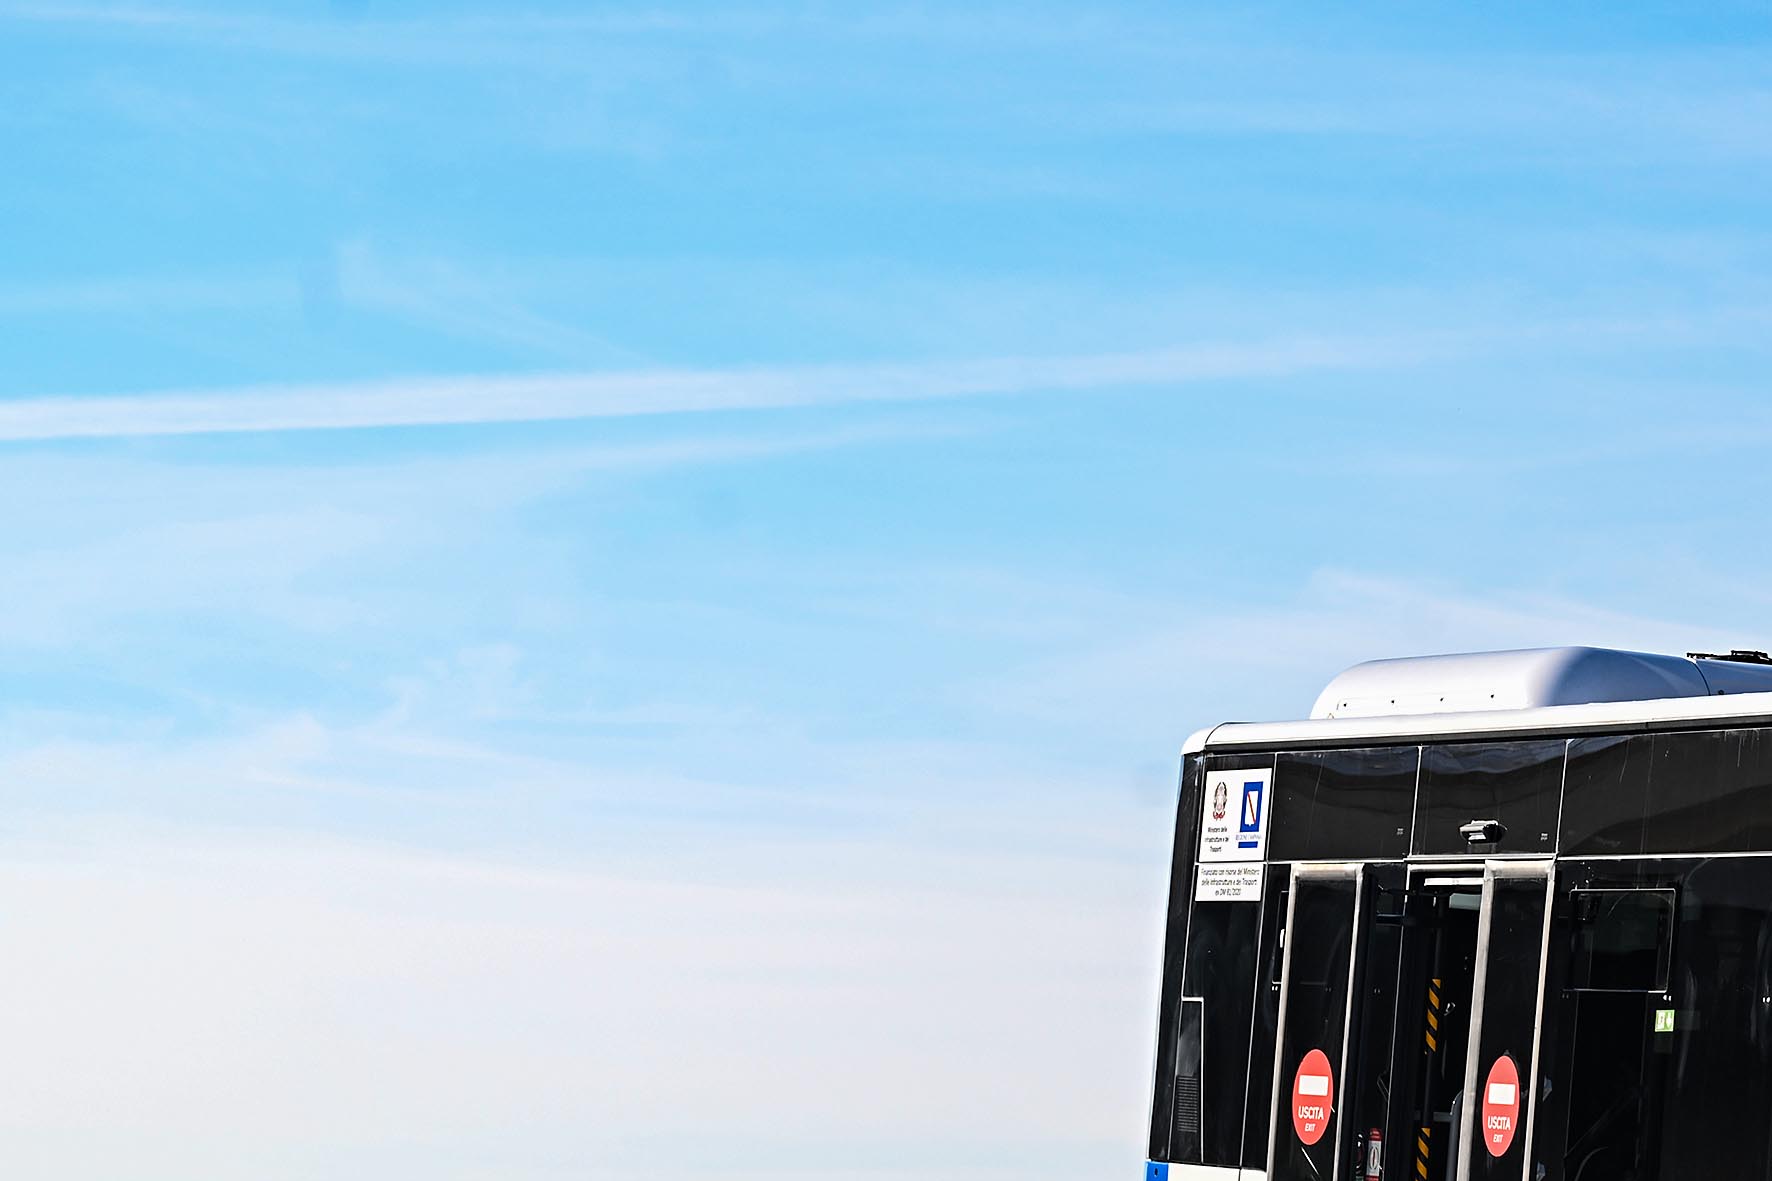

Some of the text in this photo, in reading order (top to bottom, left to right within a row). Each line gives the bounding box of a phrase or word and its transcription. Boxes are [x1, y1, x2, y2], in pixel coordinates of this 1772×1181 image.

[1298, 1105, 1324, 1120] USCITA
[1304, 1123, 1316, 1132] EXIT
[1487, 1116, 1511, 1131] USCITA
[1492, 1133, 1504, 1143] EXIT
